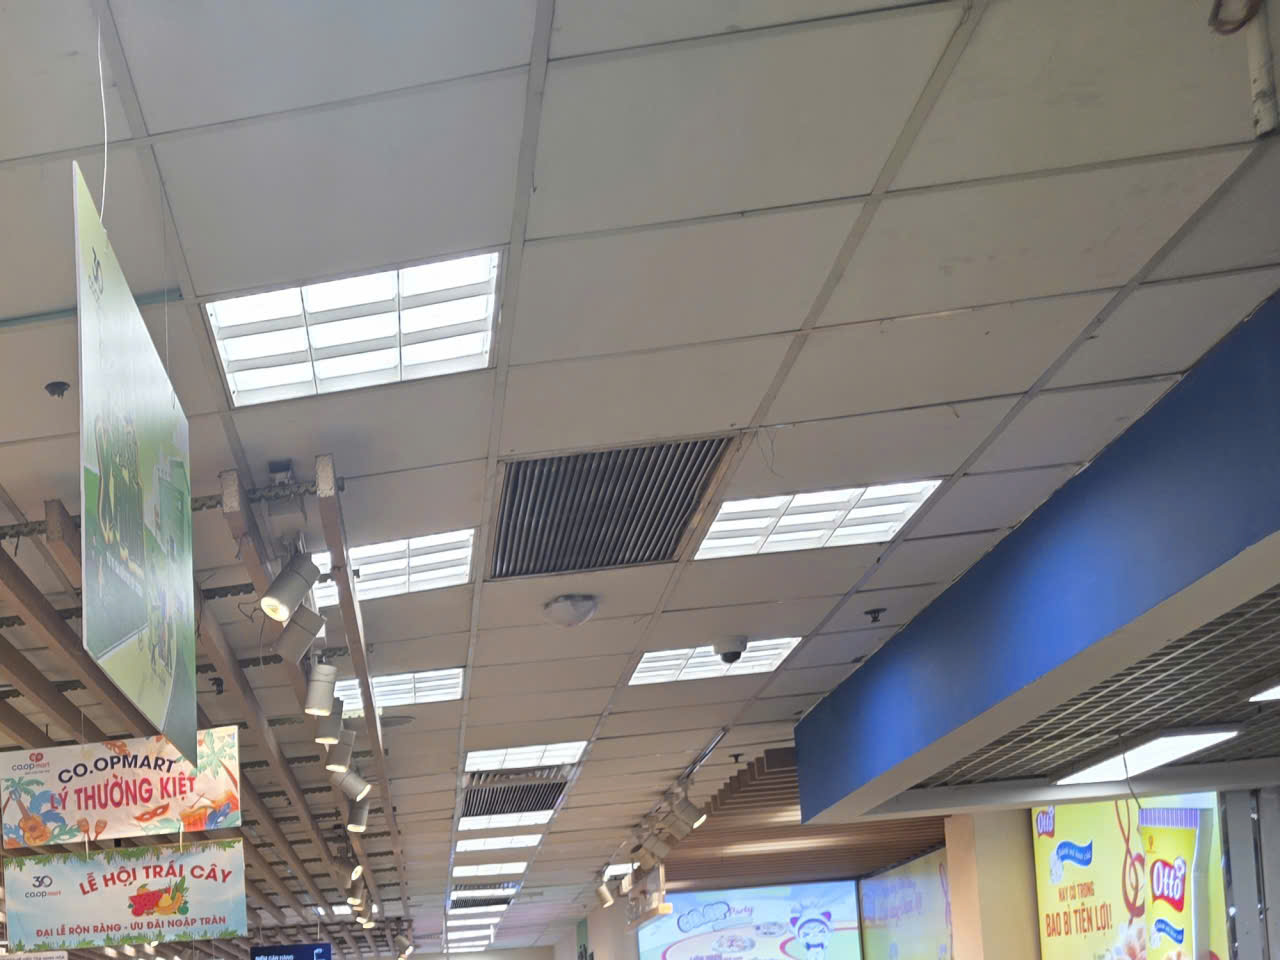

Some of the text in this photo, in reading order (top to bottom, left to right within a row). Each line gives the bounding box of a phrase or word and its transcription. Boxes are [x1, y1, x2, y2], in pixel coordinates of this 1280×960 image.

[58, 753, 176, 783] CO.OPMART
[50, 771, 196, 811] LÝ THƯỜNG KIỆT
[79, 860, 232, 896] LỄ HỘI TRÁI CÂY
[1077, 881, 1095, 899] TRONG
[1153, 856, 1186, 900] Otto
[36, 928, 54, 939] ĐẠI
[56, 924, 66, 936] LỄ
[69, 923, 90, 936] RỘN
[93, 921, 121, 934] RÀNG
[130, 920, 144, 931] ƯU
[147, 917, 165, 929] ĐÃI
[167, 917, 197, 930] NGẬP
[200, 915, 227, 926] TRÀN
[1045, 901, 1113, 939] BAO BÌ TIỆN LỢI!
